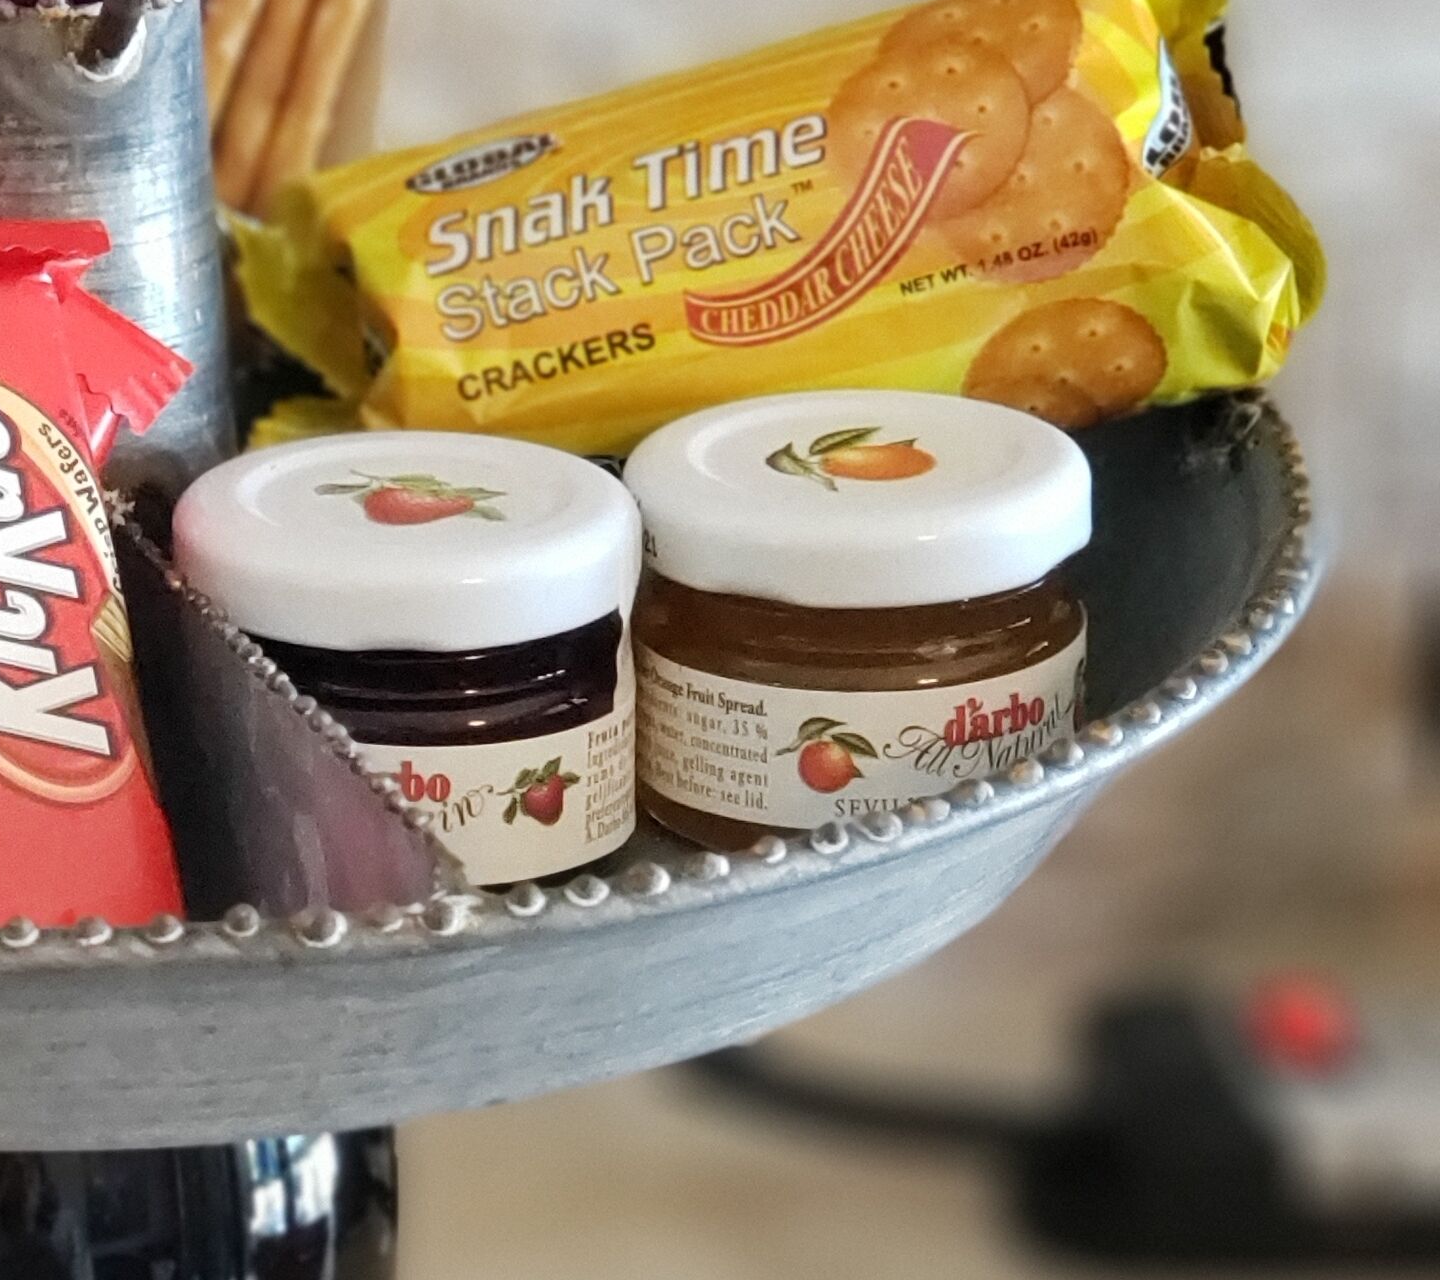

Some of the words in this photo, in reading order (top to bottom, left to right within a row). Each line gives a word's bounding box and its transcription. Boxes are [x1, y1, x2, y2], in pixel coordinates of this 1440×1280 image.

[425, 170, 615, 279] Snak
[633, 113, 829, 211] Time
[699, 259, 837, 337] CHEDDAR
[833, 134, 925, 290] CHEESE
[436, 245, 621, 343] Stack
[630, 192, 803, 285] Pack
[898, 269, 937, 298] NET
[939, 262, 974, 287] WT.
[1016, 241, 1051, 265] OZ.
[1052, 227, 1099, 257] (42g)
[456, 321, 658, 403] CRACKERS
[37, 422, 100, 515] Wafers
[686, 681, 715, 708] Fruit
[717, 691, 769, 717] Spread.
[882, 724, 953, 778] All
[953, 693, 1073, 780] Natural
[682, 754, 726, 783] gelling
[729, 772, 769, 788] agent
[690, 734, 769, 765] concentrated
[719, 788, 741, 806] see
[744, 789, 769, 811] lid.
